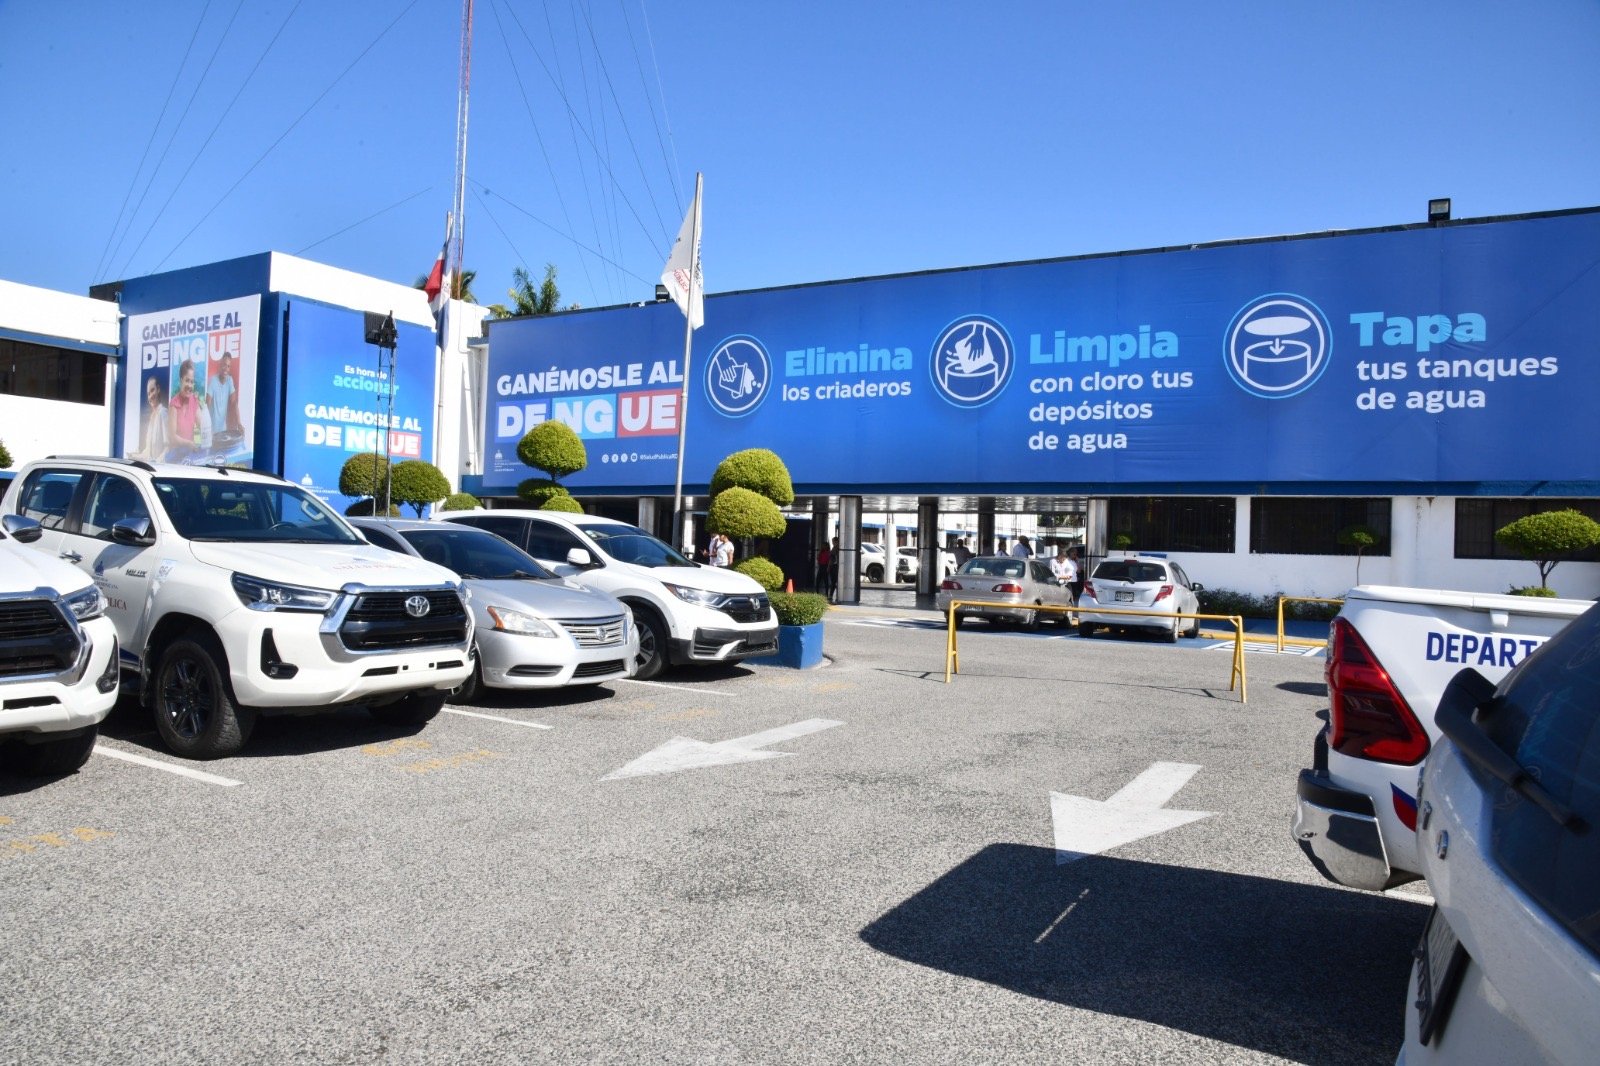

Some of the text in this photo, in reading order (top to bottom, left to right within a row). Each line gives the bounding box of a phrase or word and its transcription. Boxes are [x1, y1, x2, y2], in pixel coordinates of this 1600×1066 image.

[142, 311, 242, 341] GANÉMOSLE AL
[1350, 311, 1487, 352] Tapa
[1030, 325, 1179, 367] Limpia
[344, 365, 387, 380] Es hora de
[785, 344, 913, 377] Elimina
[1356, 356, 1559, 382] tus tanques
[333, 375, 399, 395] accionar
[497, 360, 684, 396] GANÉMOSLE AL
[782, 380, 912, 401] los criaderos
[1029, 370, 1194, 394] con cloro tus
[1029, 400, 1153, 425] depósitos
[1356, 388, 1486, 413] de agua
[304, 403, 422, 432] GANÉMOSLE AL
[1028, 431, 1128, 453] de agua
[1426, 631, 1546, 668] DEPART
